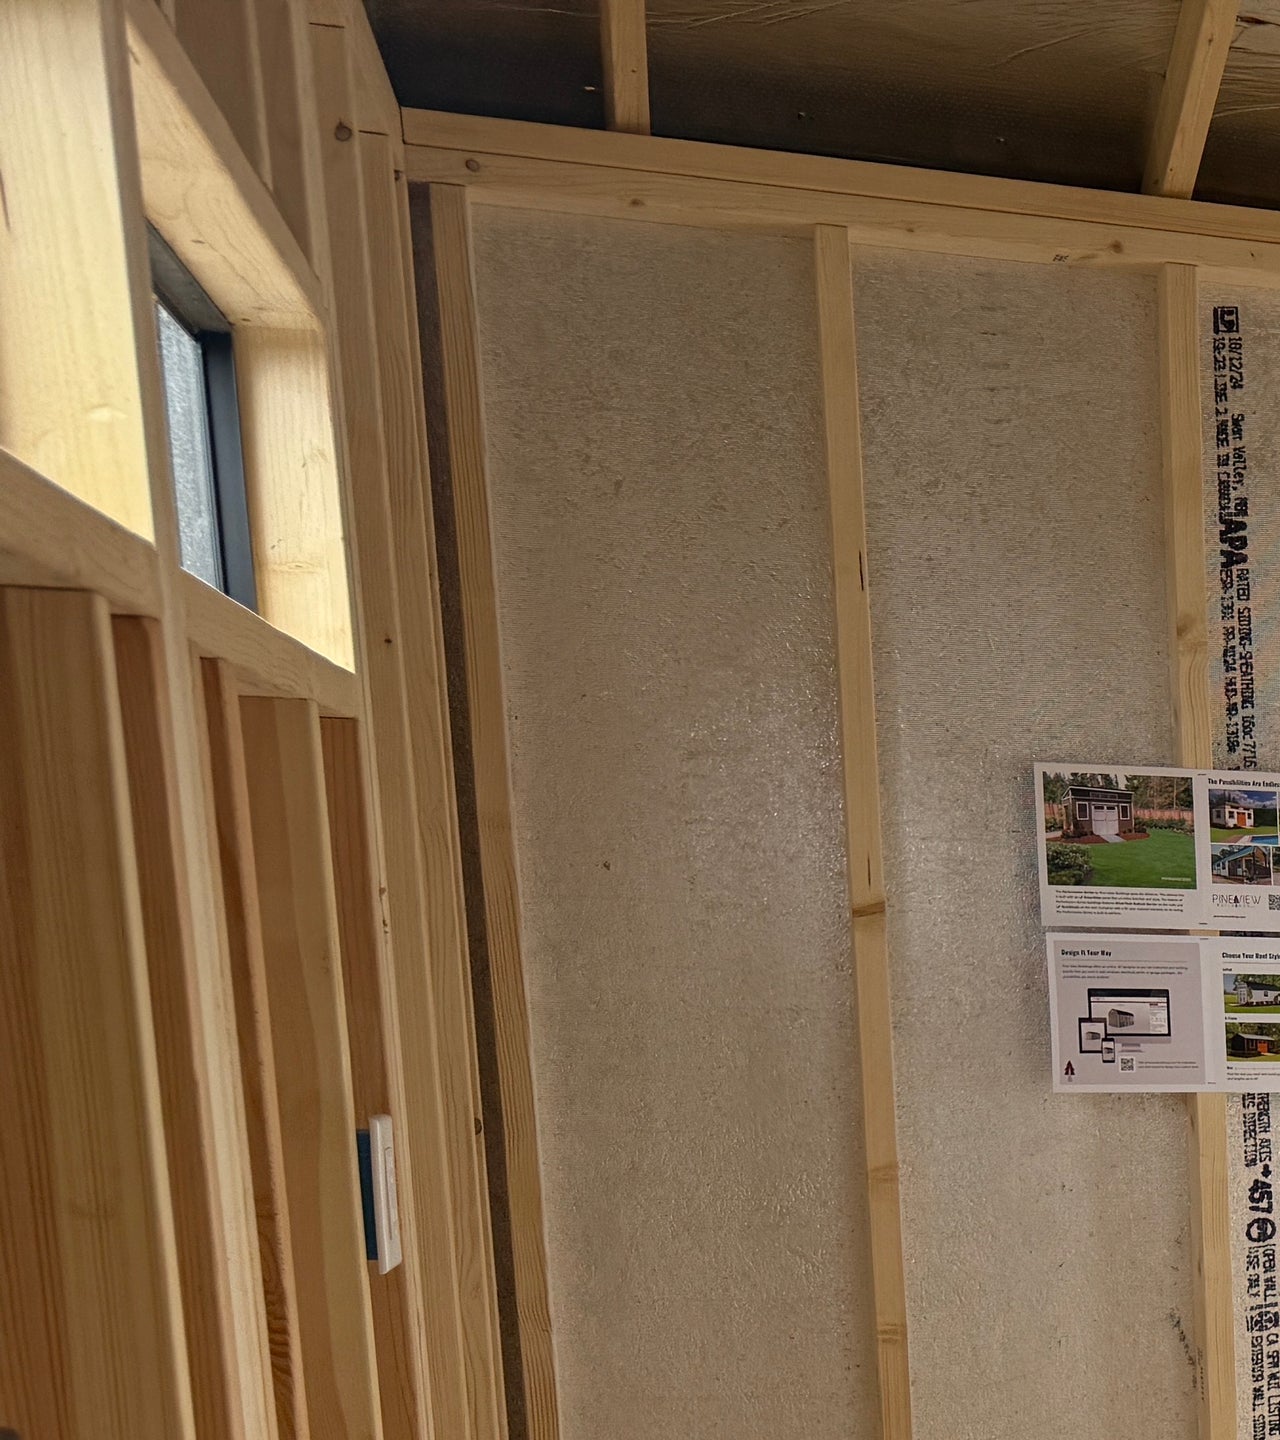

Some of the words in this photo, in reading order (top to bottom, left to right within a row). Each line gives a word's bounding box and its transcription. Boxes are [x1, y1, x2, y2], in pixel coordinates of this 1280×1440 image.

[1219, 520, 1248, 569] APA
[1236, 568, 1250, 601] RATED
[1258, 1138, 1272, 1163] AXIS
[1249, 1179, 1273, 1214] 457
[1263, 1249, 1276, 1272] OPEN
[1264, 1276, 1277, 1303] WALL
[1266, 1333, 1279, 1345] CA
[1267, 1394, 1280, 1436] LISTING
